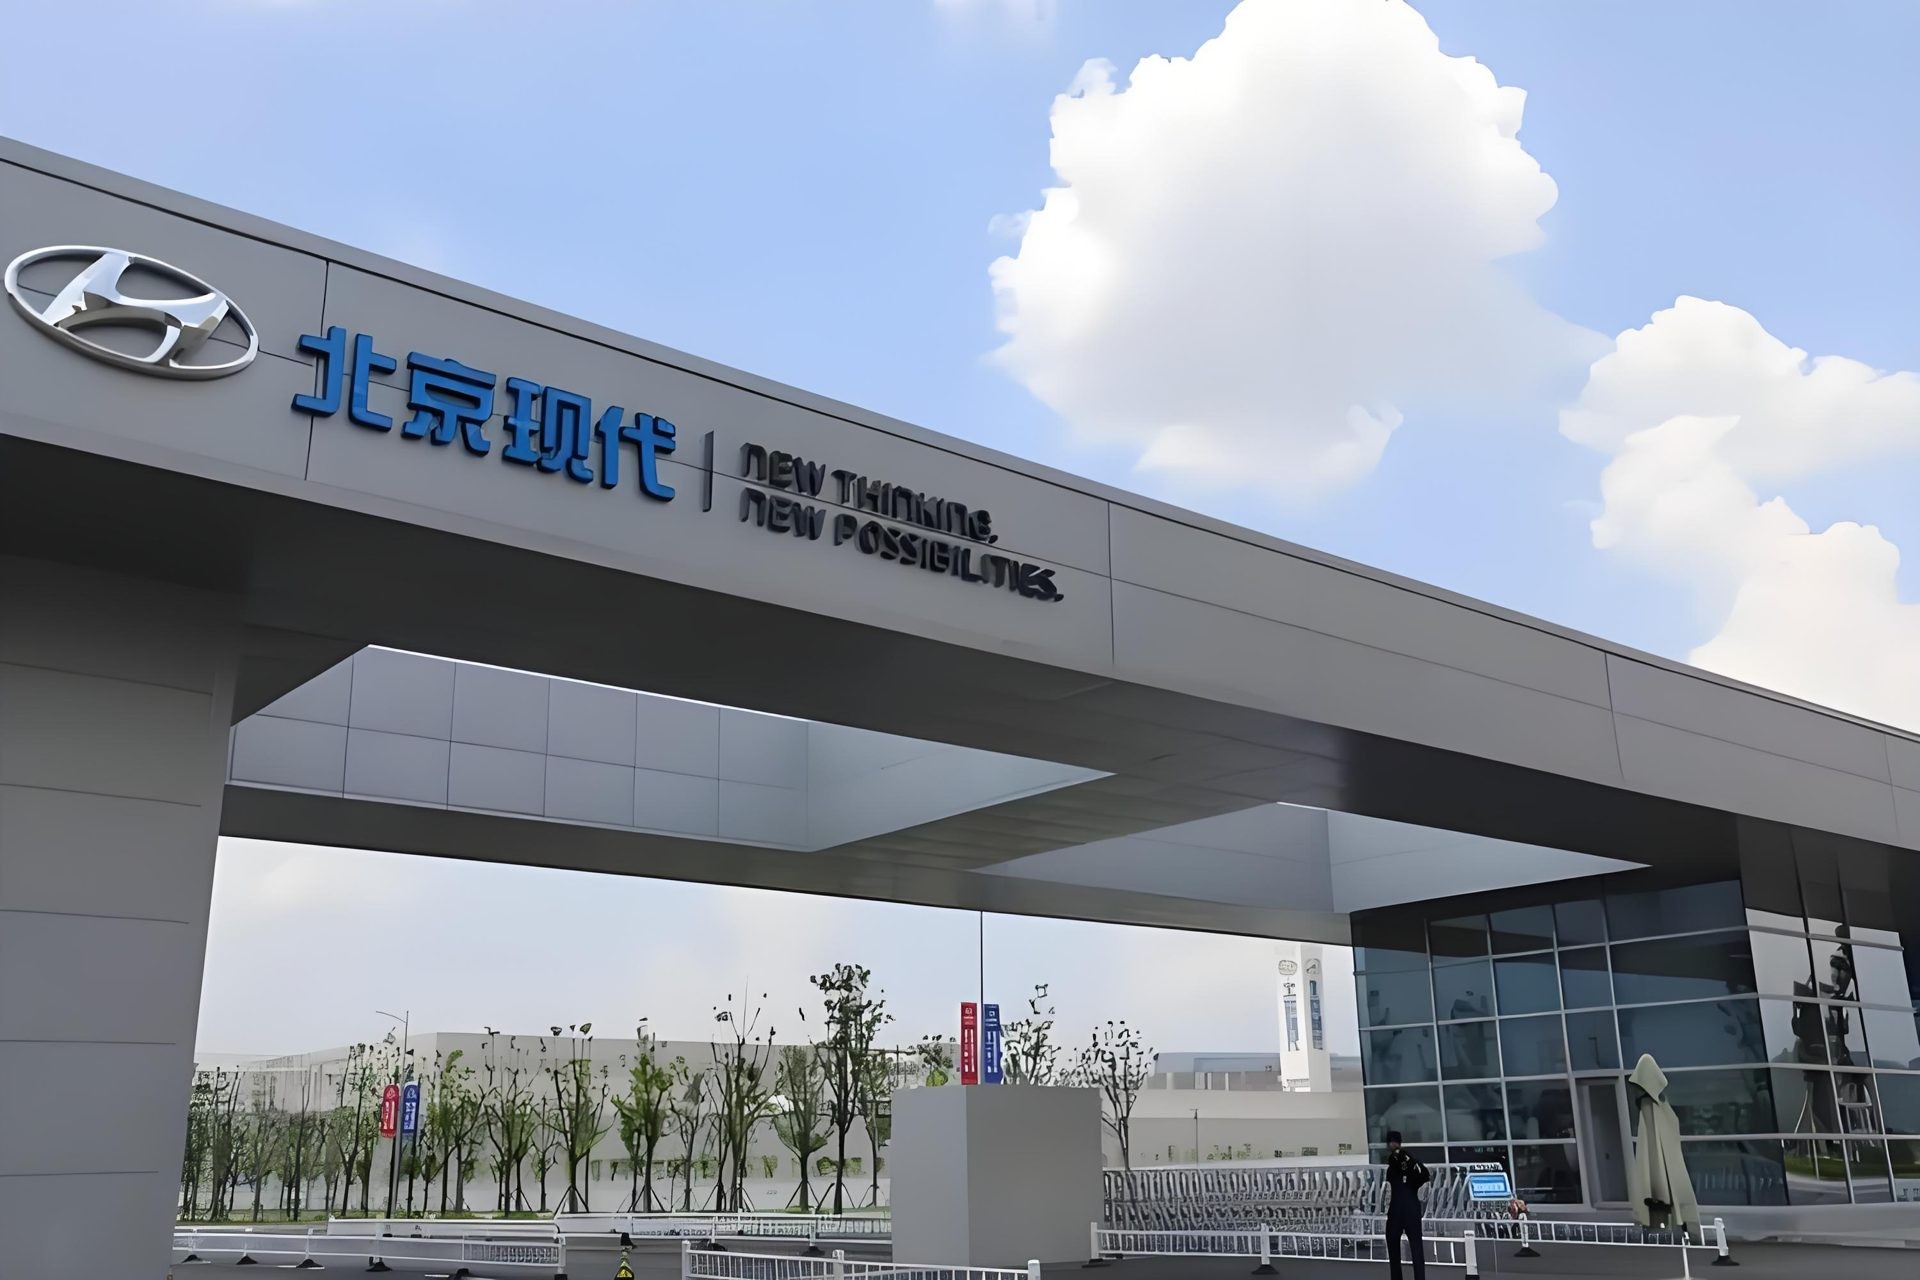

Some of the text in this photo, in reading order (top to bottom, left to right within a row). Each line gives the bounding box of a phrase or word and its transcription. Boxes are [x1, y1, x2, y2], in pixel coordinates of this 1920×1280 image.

[291, 325, 676, 502] 北京现代
[739, 442, 826, 497] NEW
[738, 486, 827, 541] NEW
